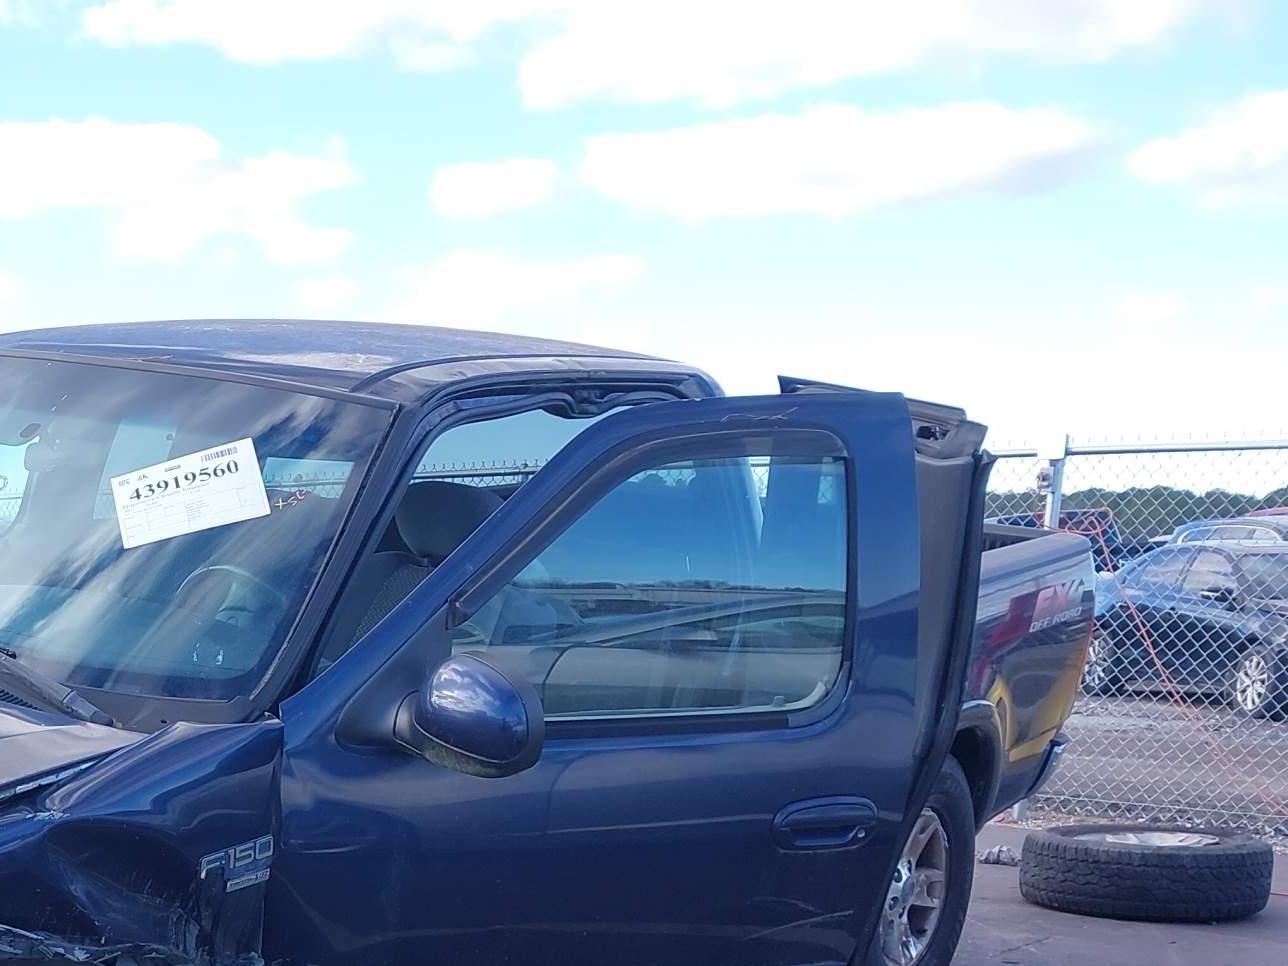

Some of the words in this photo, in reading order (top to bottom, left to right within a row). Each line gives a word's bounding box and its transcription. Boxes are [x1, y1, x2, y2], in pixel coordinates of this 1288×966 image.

[129, 459, 240, 501] 43919560
[1029, 616, 1053, 633] OFF
[1053, 607, 1083, 625] ROAD
